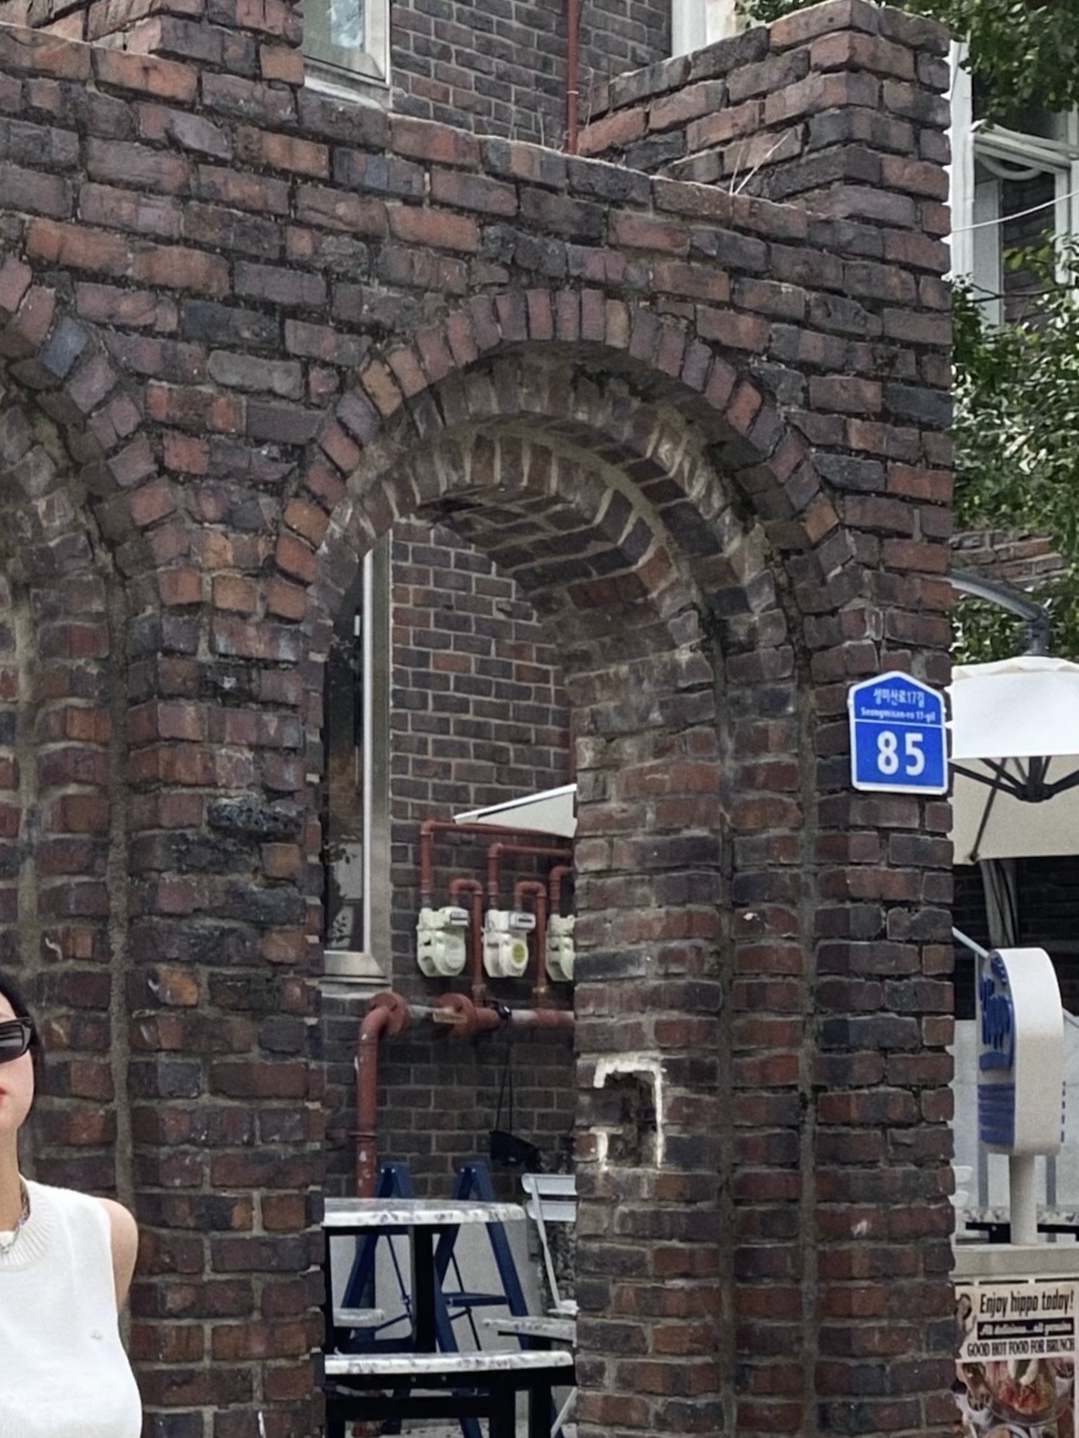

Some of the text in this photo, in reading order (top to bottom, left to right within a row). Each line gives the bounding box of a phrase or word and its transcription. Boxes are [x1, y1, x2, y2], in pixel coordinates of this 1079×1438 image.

[877, 730, 925, 776] 85
[980, 1288, 1074, 1318] Enjoy hippo today!
[967, 1342, 990, 1357] GOOD
[1008, 1340, 1029, 1355] FOOD
[1031, 1339, 1045, 1354] FOR
